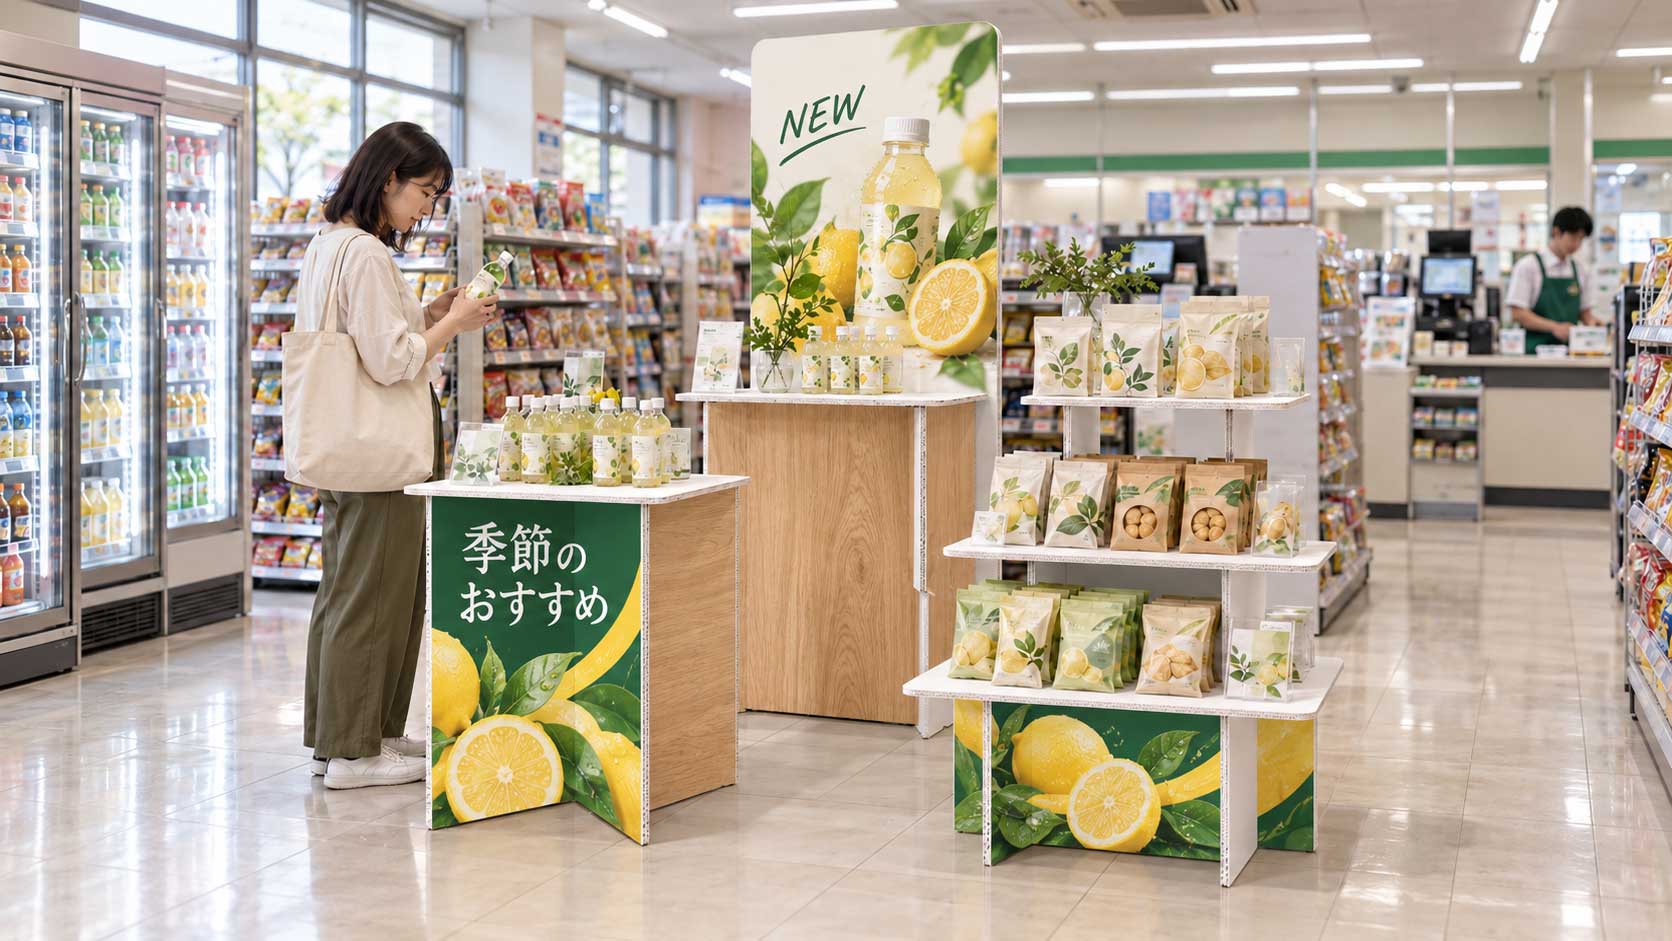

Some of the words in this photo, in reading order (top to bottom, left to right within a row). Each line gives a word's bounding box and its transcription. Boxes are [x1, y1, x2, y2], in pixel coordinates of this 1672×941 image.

[780, 84, 866, 145] NEW
[462, 521, 587, 575] 季節の
[459, 581, 609, 627] おすすめ
